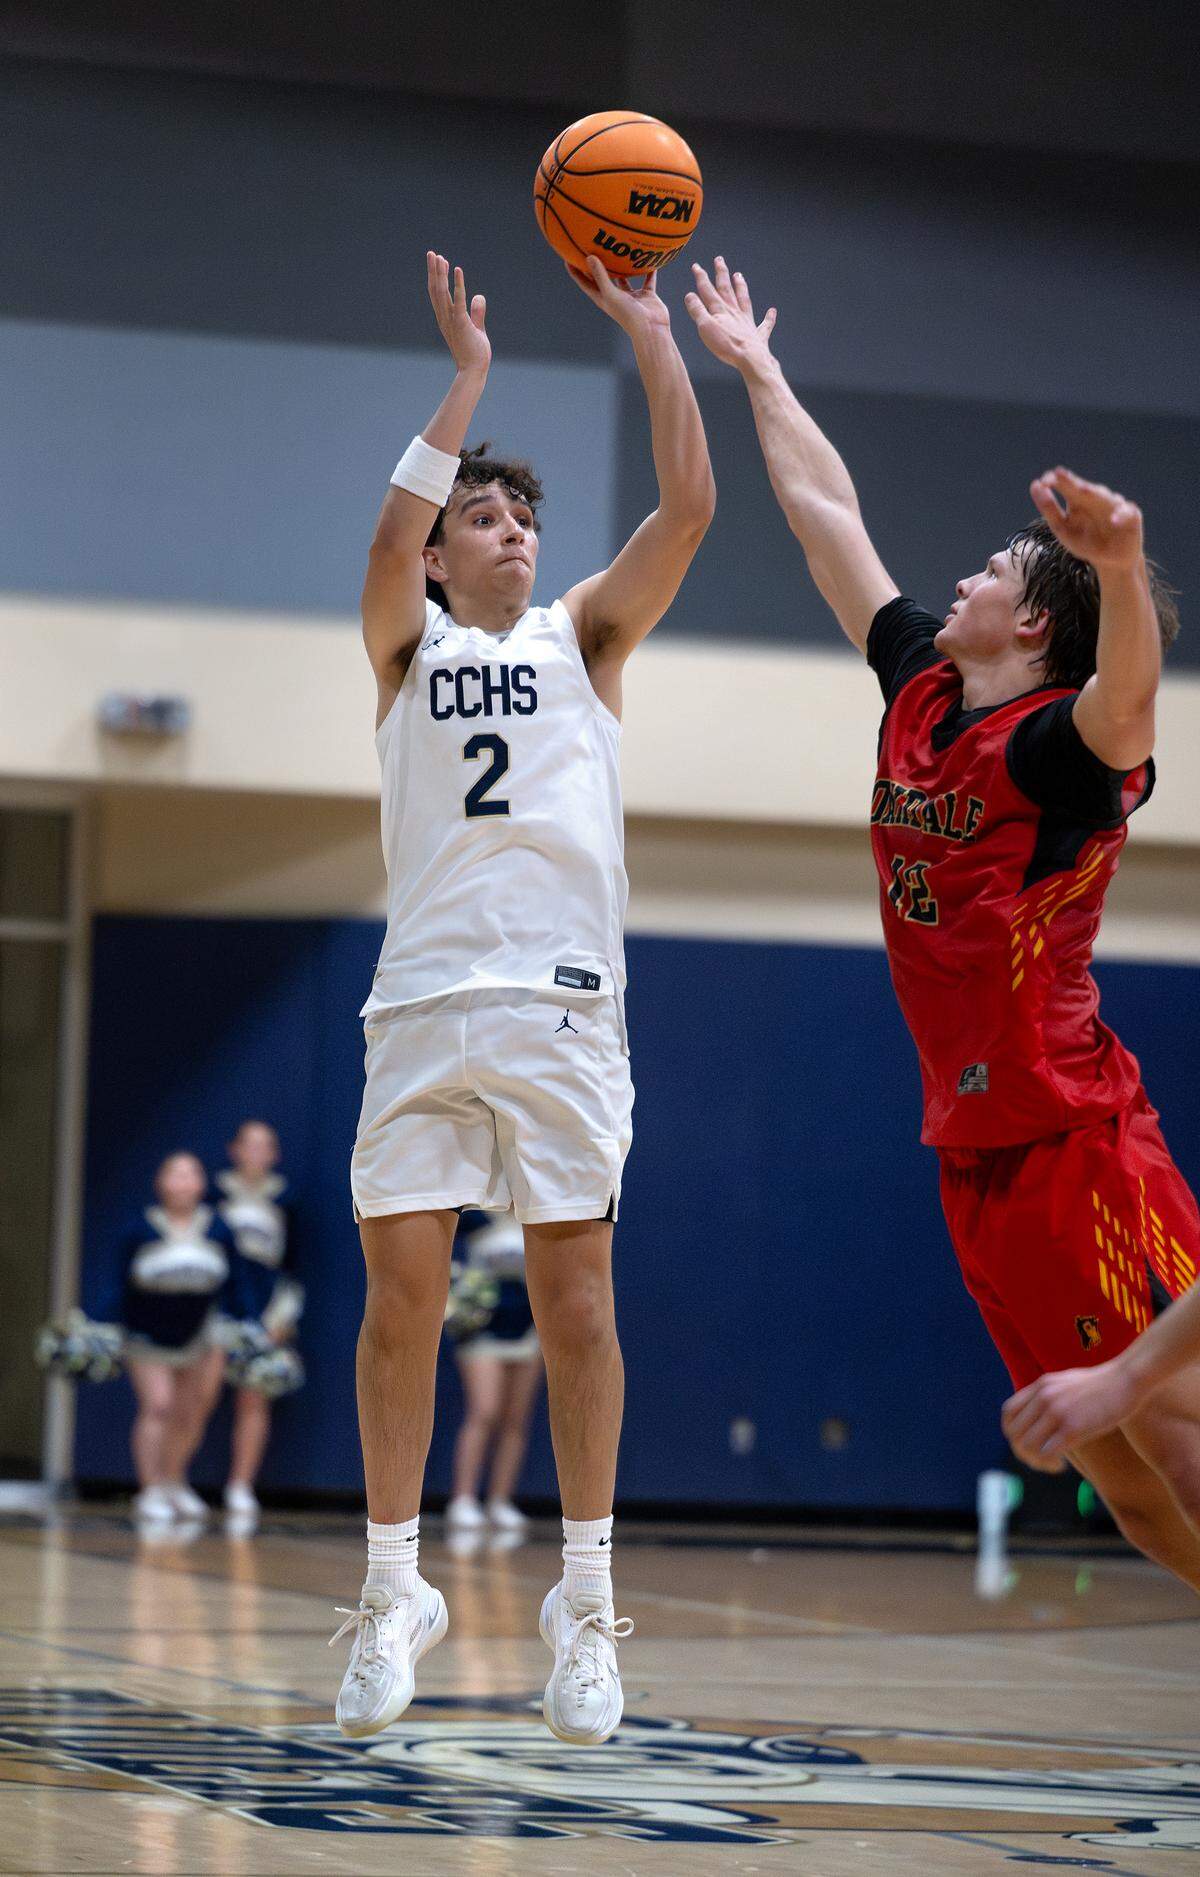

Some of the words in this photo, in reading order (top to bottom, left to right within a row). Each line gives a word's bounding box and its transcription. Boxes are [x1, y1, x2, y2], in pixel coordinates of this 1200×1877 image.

[628, 190, 695, 223] NCAA
[429, 664, 538, 721] CCHS
[461, 732, 511, 819] 2
[888, 854, 939, 926] 12
[587, 977, 597, 989] M
